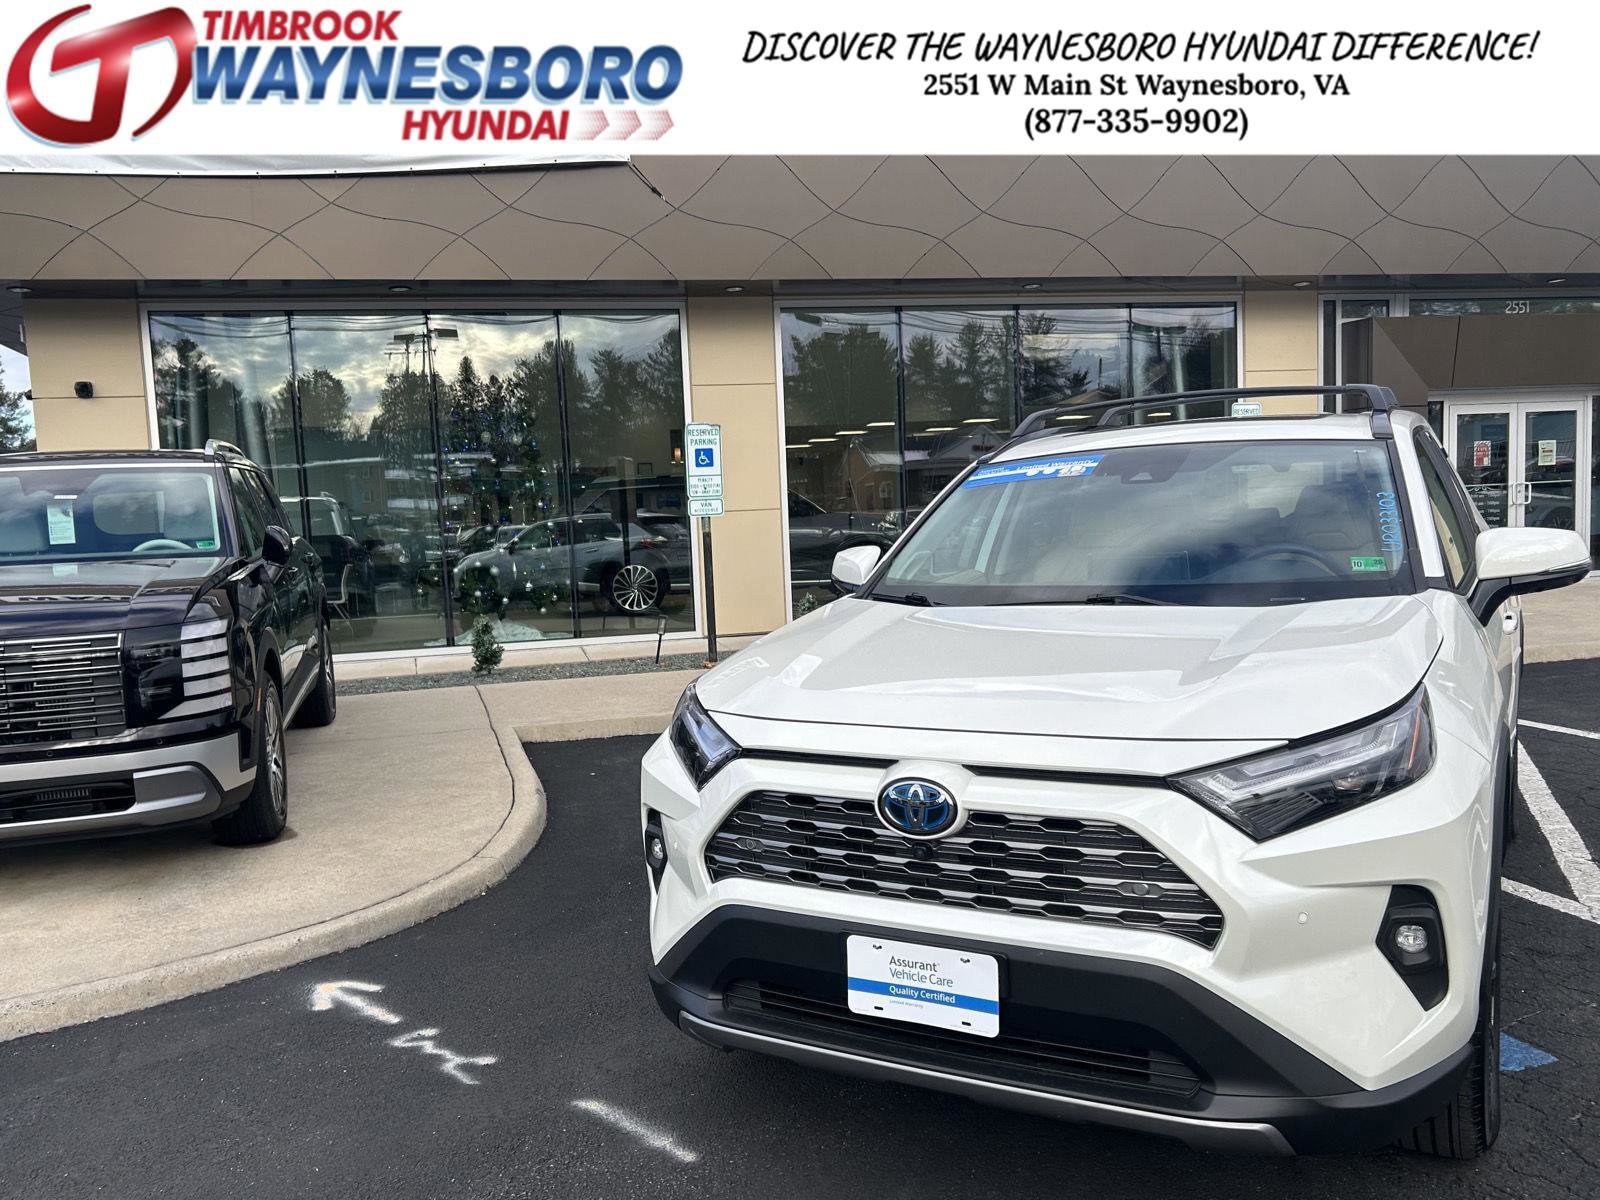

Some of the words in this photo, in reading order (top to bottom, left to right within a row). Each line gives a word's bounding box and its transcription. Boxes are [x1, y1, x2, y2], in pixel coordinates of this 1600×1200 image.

[1505, 300, 1530, 314] 2551
[687, 428, 719, 437] RESERVED
[690, 438, 718, 446] PARKING
[1353, 560, 1363, 568] 10
[889, 955, 938, 972] Assurant
[889, 967, 928, 984] Vehicle
[928, 973, 954, 988] Care
[889, 985, 919, 999] Quality
[920, 990, 956, 1004] Certified
